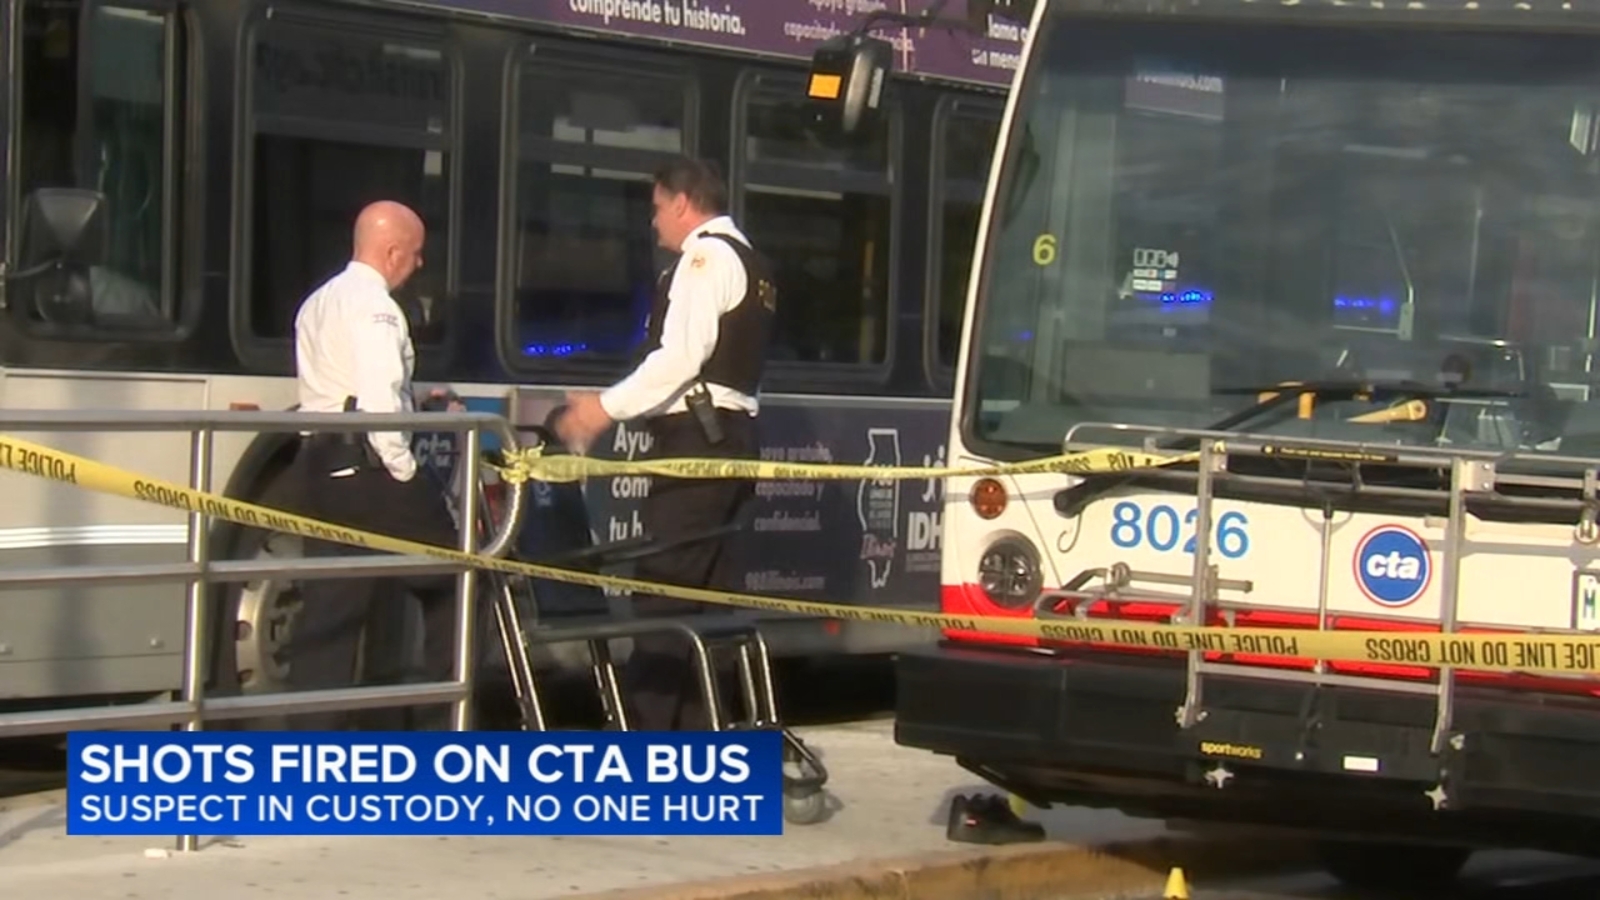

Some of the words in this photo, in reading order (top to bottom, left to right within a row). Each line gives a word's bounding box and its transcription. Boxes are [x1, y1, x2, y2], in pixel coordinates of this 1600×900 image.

[664, 6, 681, 24] tu
[684, 2, 746, 35] historia.
[1033, 234, 1057, 265] 6
[613, 422, 655, 461] Ayu
[19, 447, 77, 485] POLICE
[133, 479, 192, 512] CROSS
[612, 476, 653, 498] com
[198, 495, 230, 519] NOT
[234, 506, 257, 523] DO
[609, 515, 628, 543] tu
[1111, 500, 1250, 559] 8026
[1366, 551, 1421, 581] cta
[1040, 623, 1105, 643] CROSS
[1112, 628, 1148, 646] NOT
[1151, 630, 1179, 648] DO
[1183, 631, 1225, 651] LINE
[1230, 634, 1299, 656] POLICE
[1365, 637, 1432, 662] CROSS
[1438, 639, 1477, 665] NOT
[1483, 640, 1508, 666] DO
[1514, 641, 1559, 668] LINE
[1201, 741, 1262, 760] sportworks
